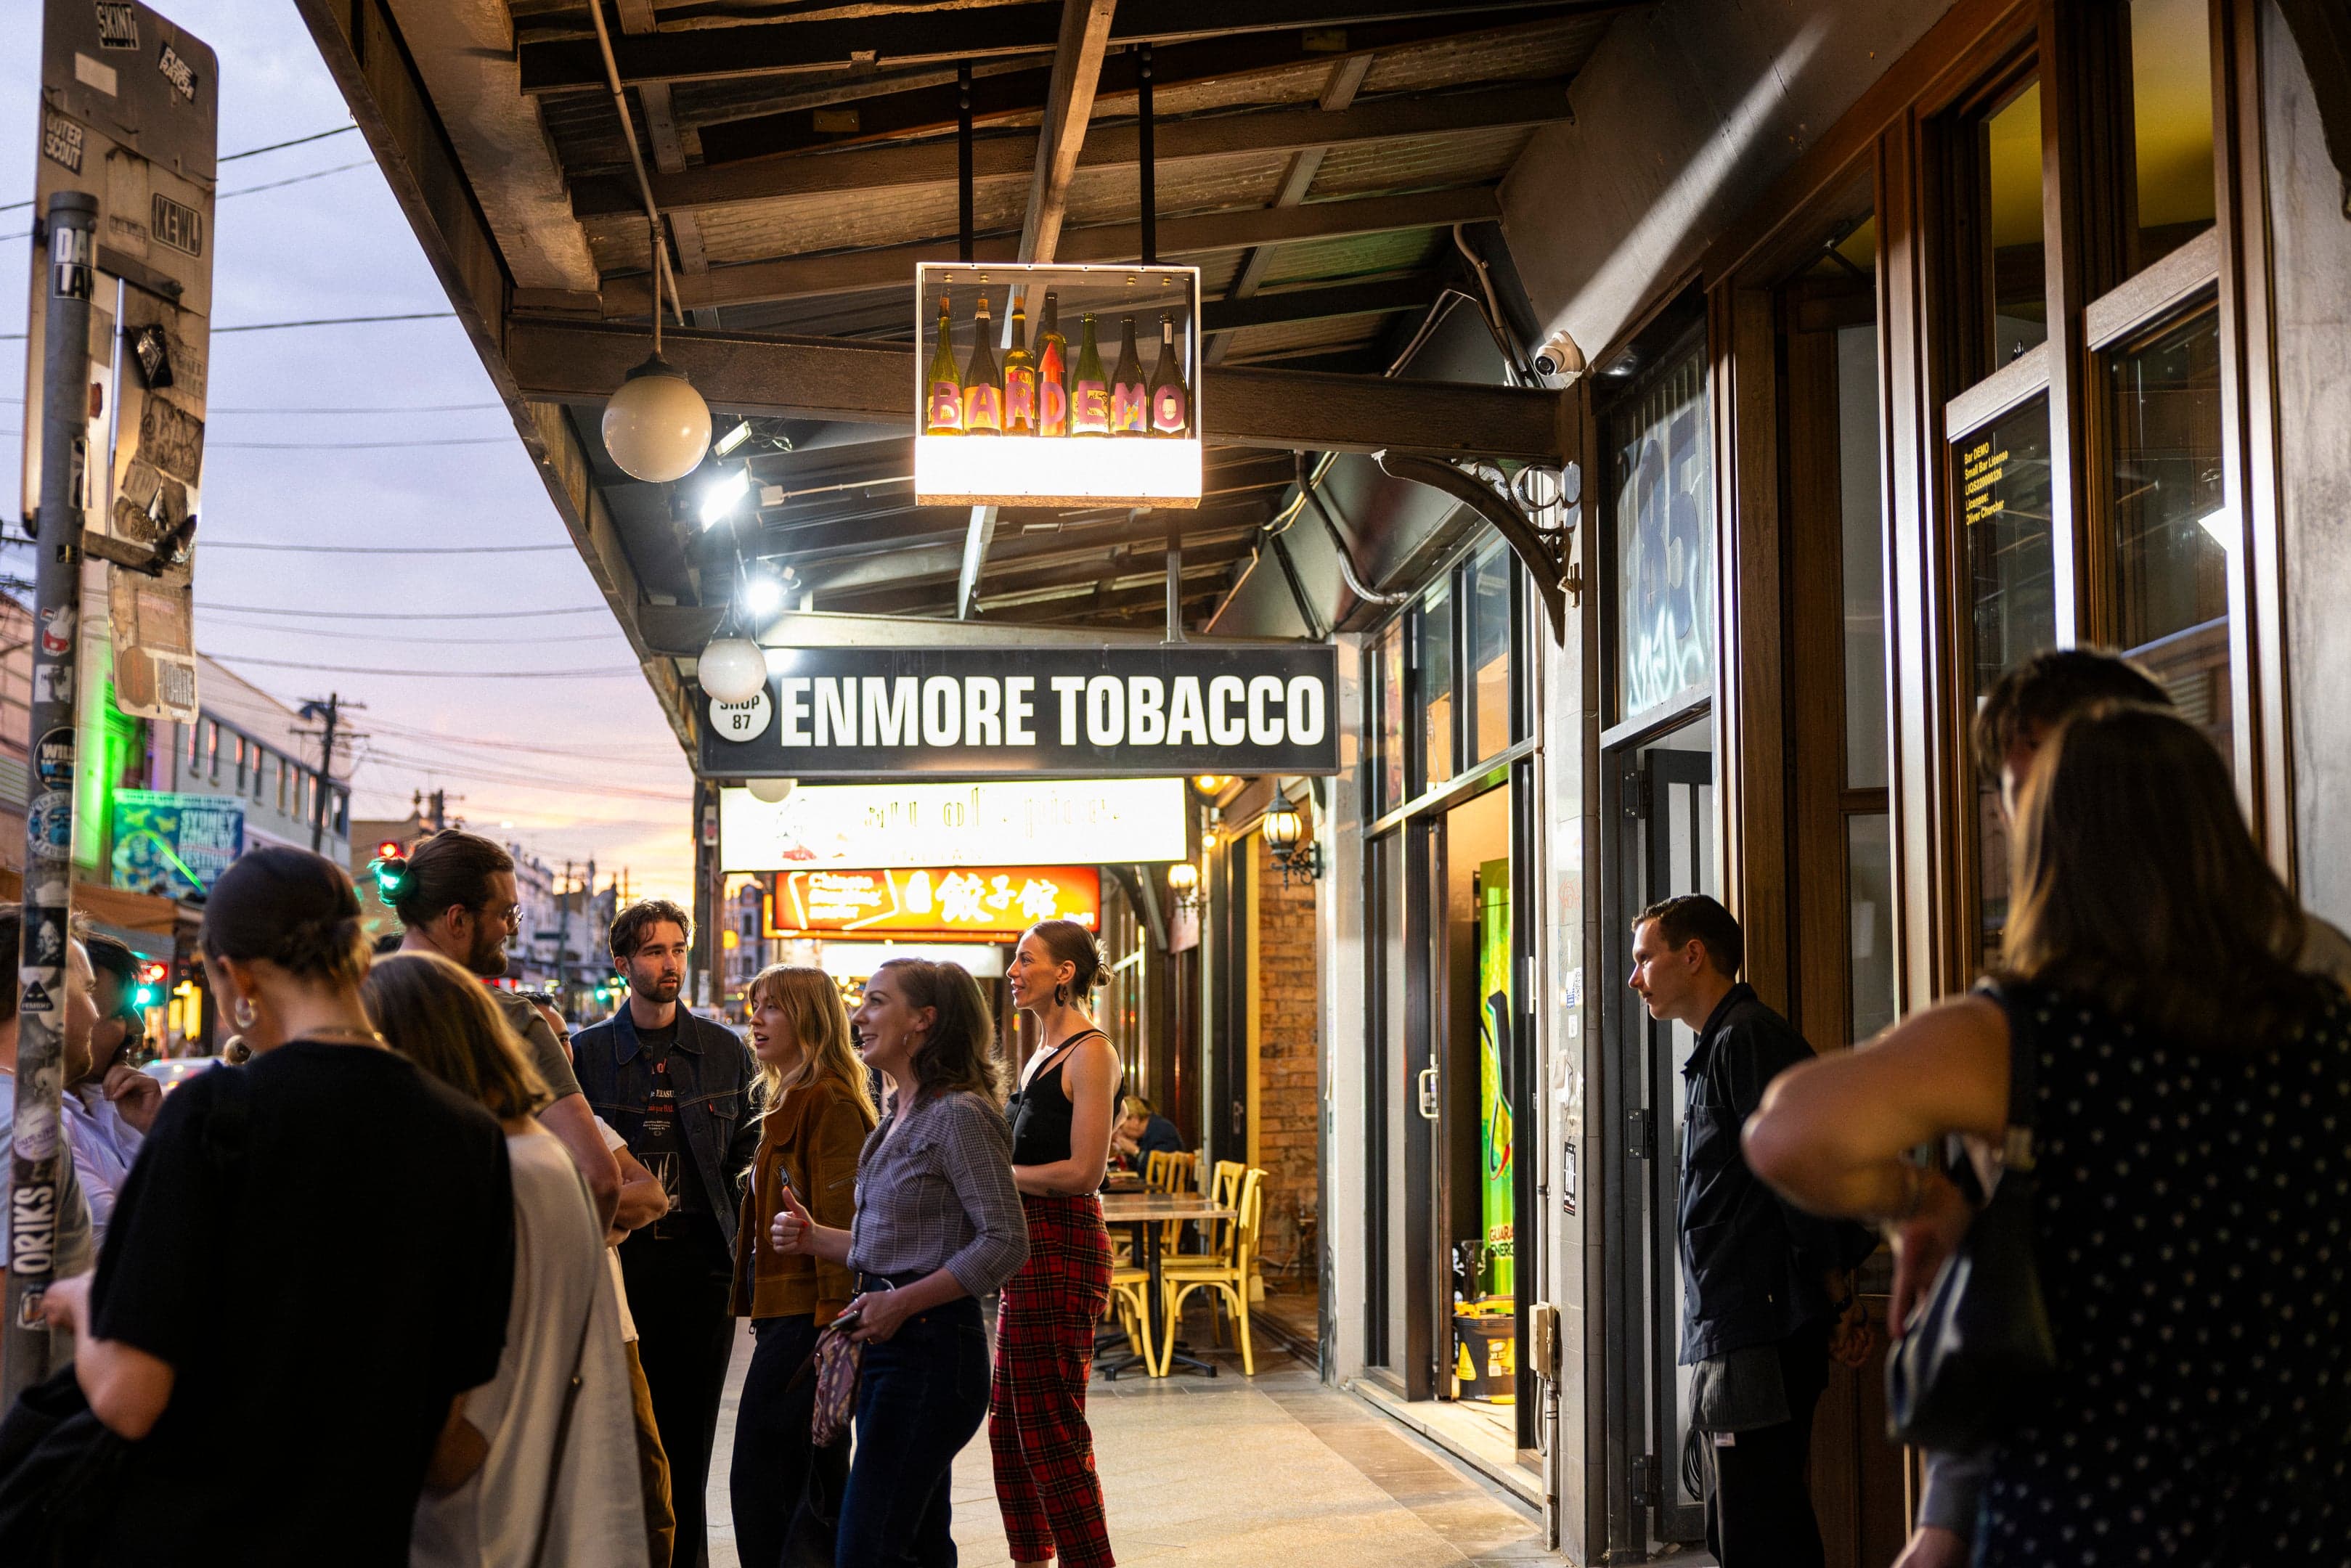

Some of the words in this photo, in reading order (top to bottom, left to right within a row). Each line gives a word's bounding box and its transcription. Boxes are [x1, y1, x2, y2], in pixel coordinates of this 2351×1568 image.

[1964, 452, 1973, 465] Bar
[1973, 442, 1989, 460] DEMO
[1965, 464, 1979, 481] Small
[1979, 460, 1988, 473] Bar
[1989, 450, 2008, 467] License
[733, 714, 751, 730] 87
[781, 676, 1036, 746] ENMORE
[1051, 676, 1324, 746] TOBACCO
